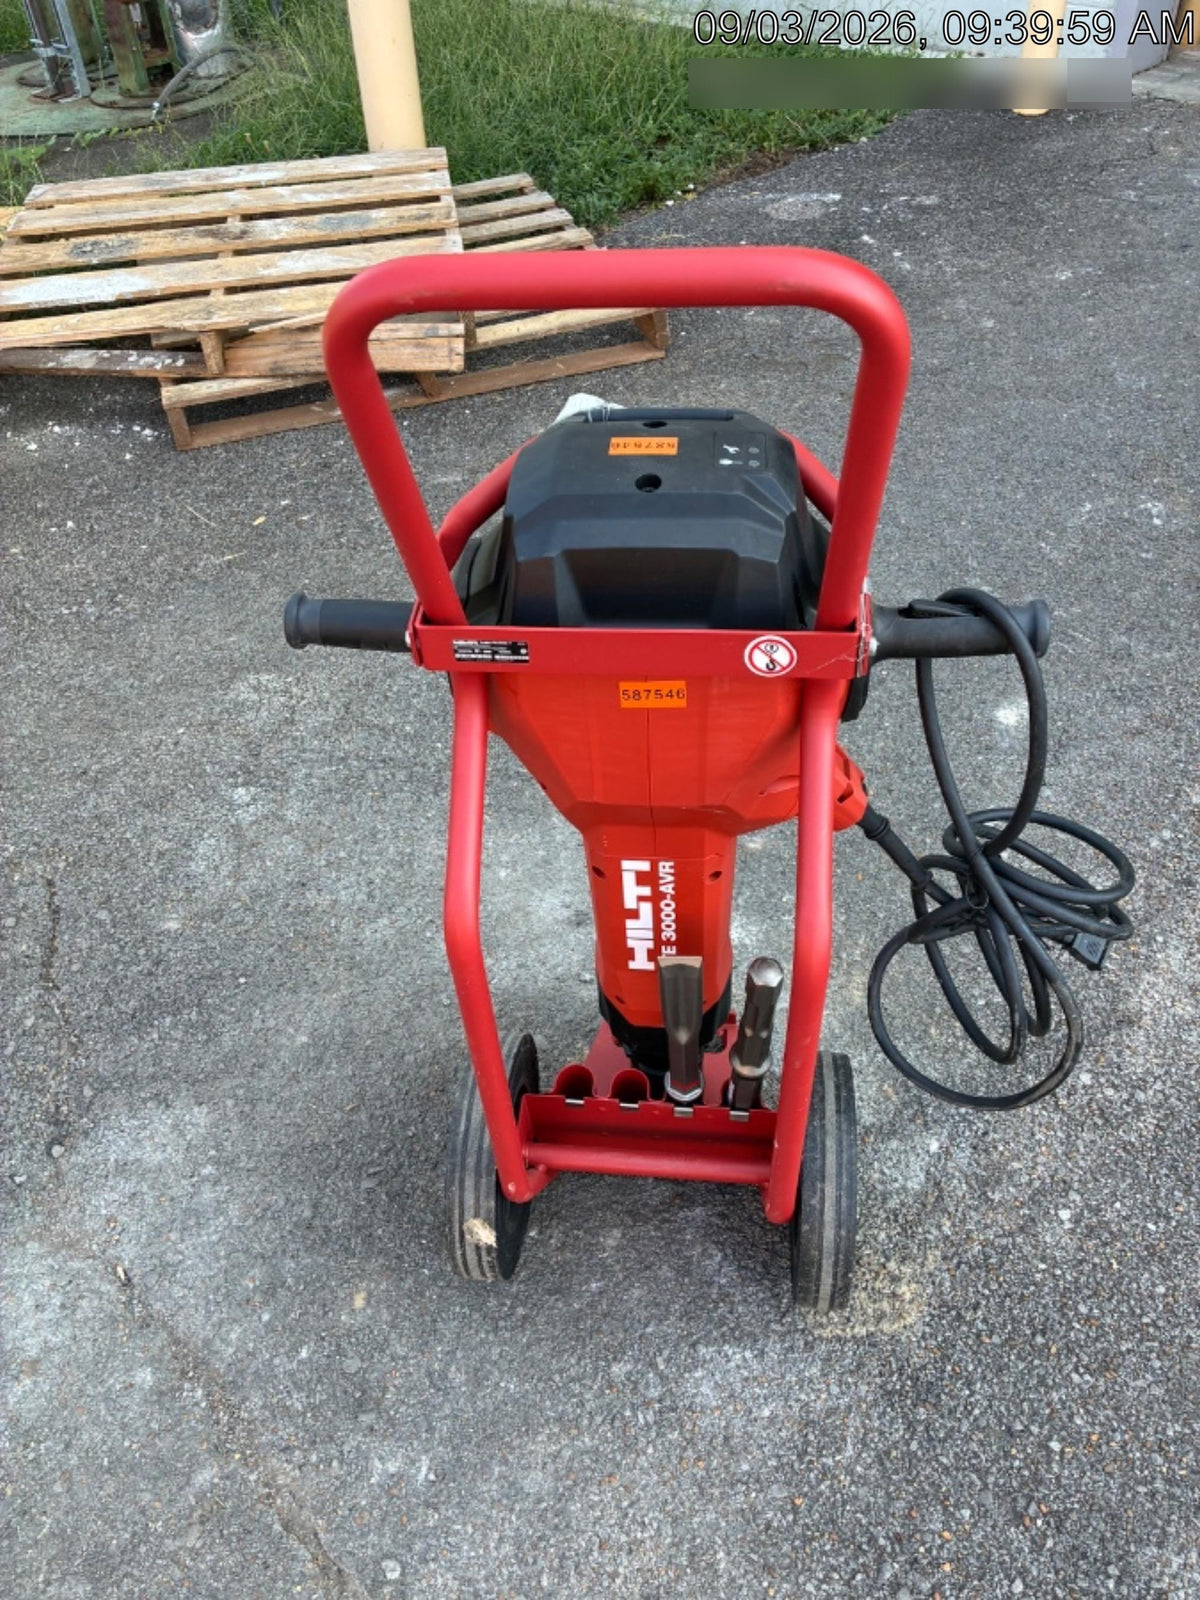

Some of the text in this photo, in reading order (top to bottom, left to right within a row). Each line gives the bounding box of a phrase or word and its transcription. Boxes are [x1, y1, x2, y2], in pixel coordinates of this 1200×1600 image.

[621, 688, 686, 701] 587546
[621, 860, 655, 971] HILTI
[658, 861, 677, 957] E 3000-AVR
